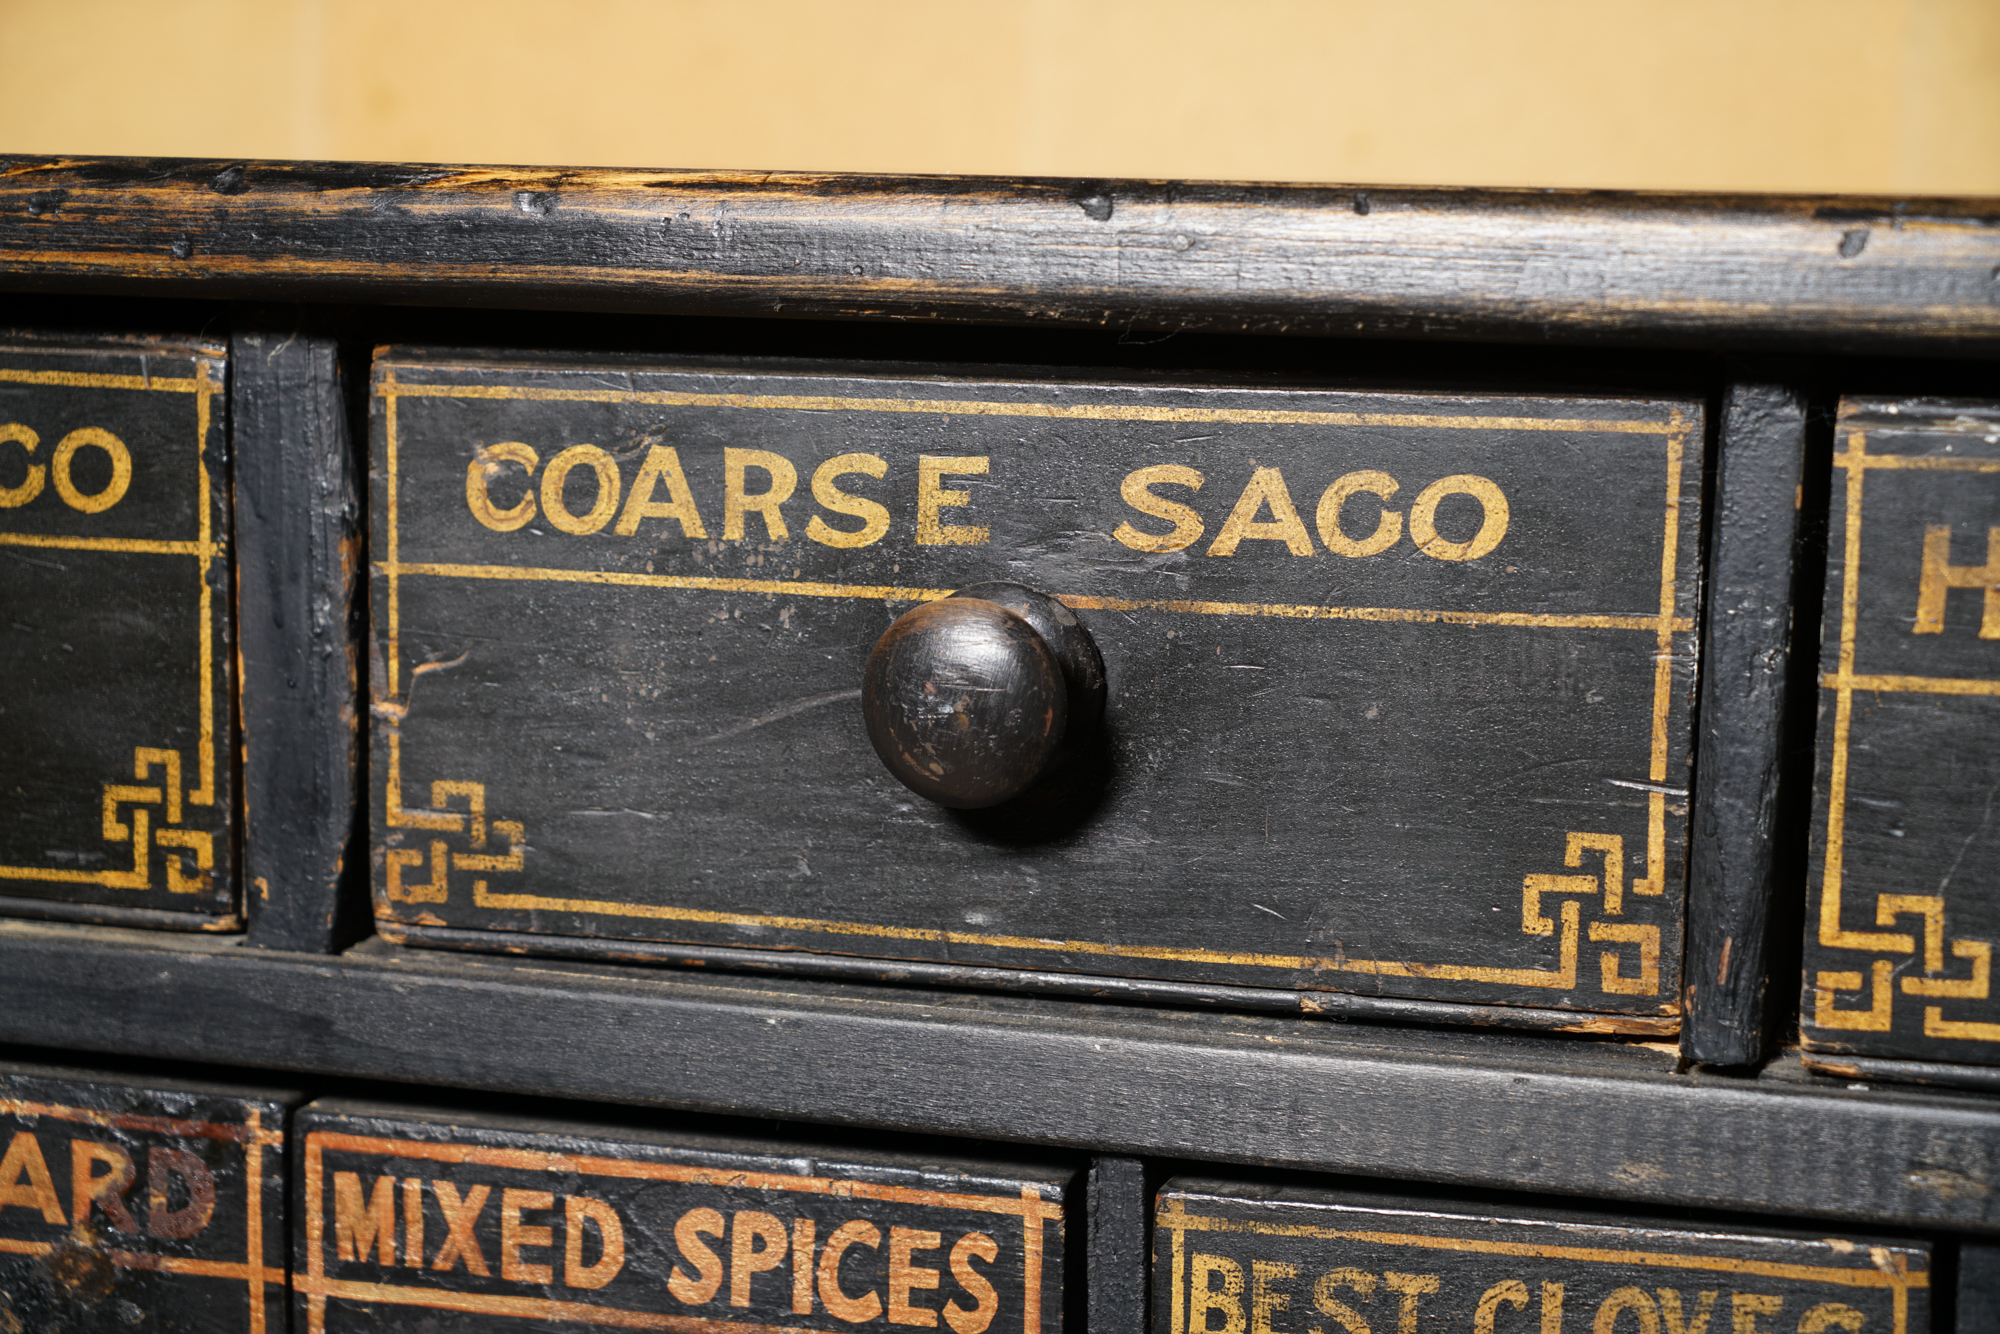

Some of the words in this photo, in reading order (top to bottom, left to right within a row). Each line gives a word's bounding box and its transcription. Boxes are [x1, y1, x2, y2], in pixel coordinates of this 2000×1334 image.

[466, 441, 990, 549] COARSE
[1113, 464, 1511, 562] SAGO
[333, 1171, 625, 1290] MIXED
[667, 1206, 999, 1334] SPICES
[1189, 1251, 1440, 1334] BEST
